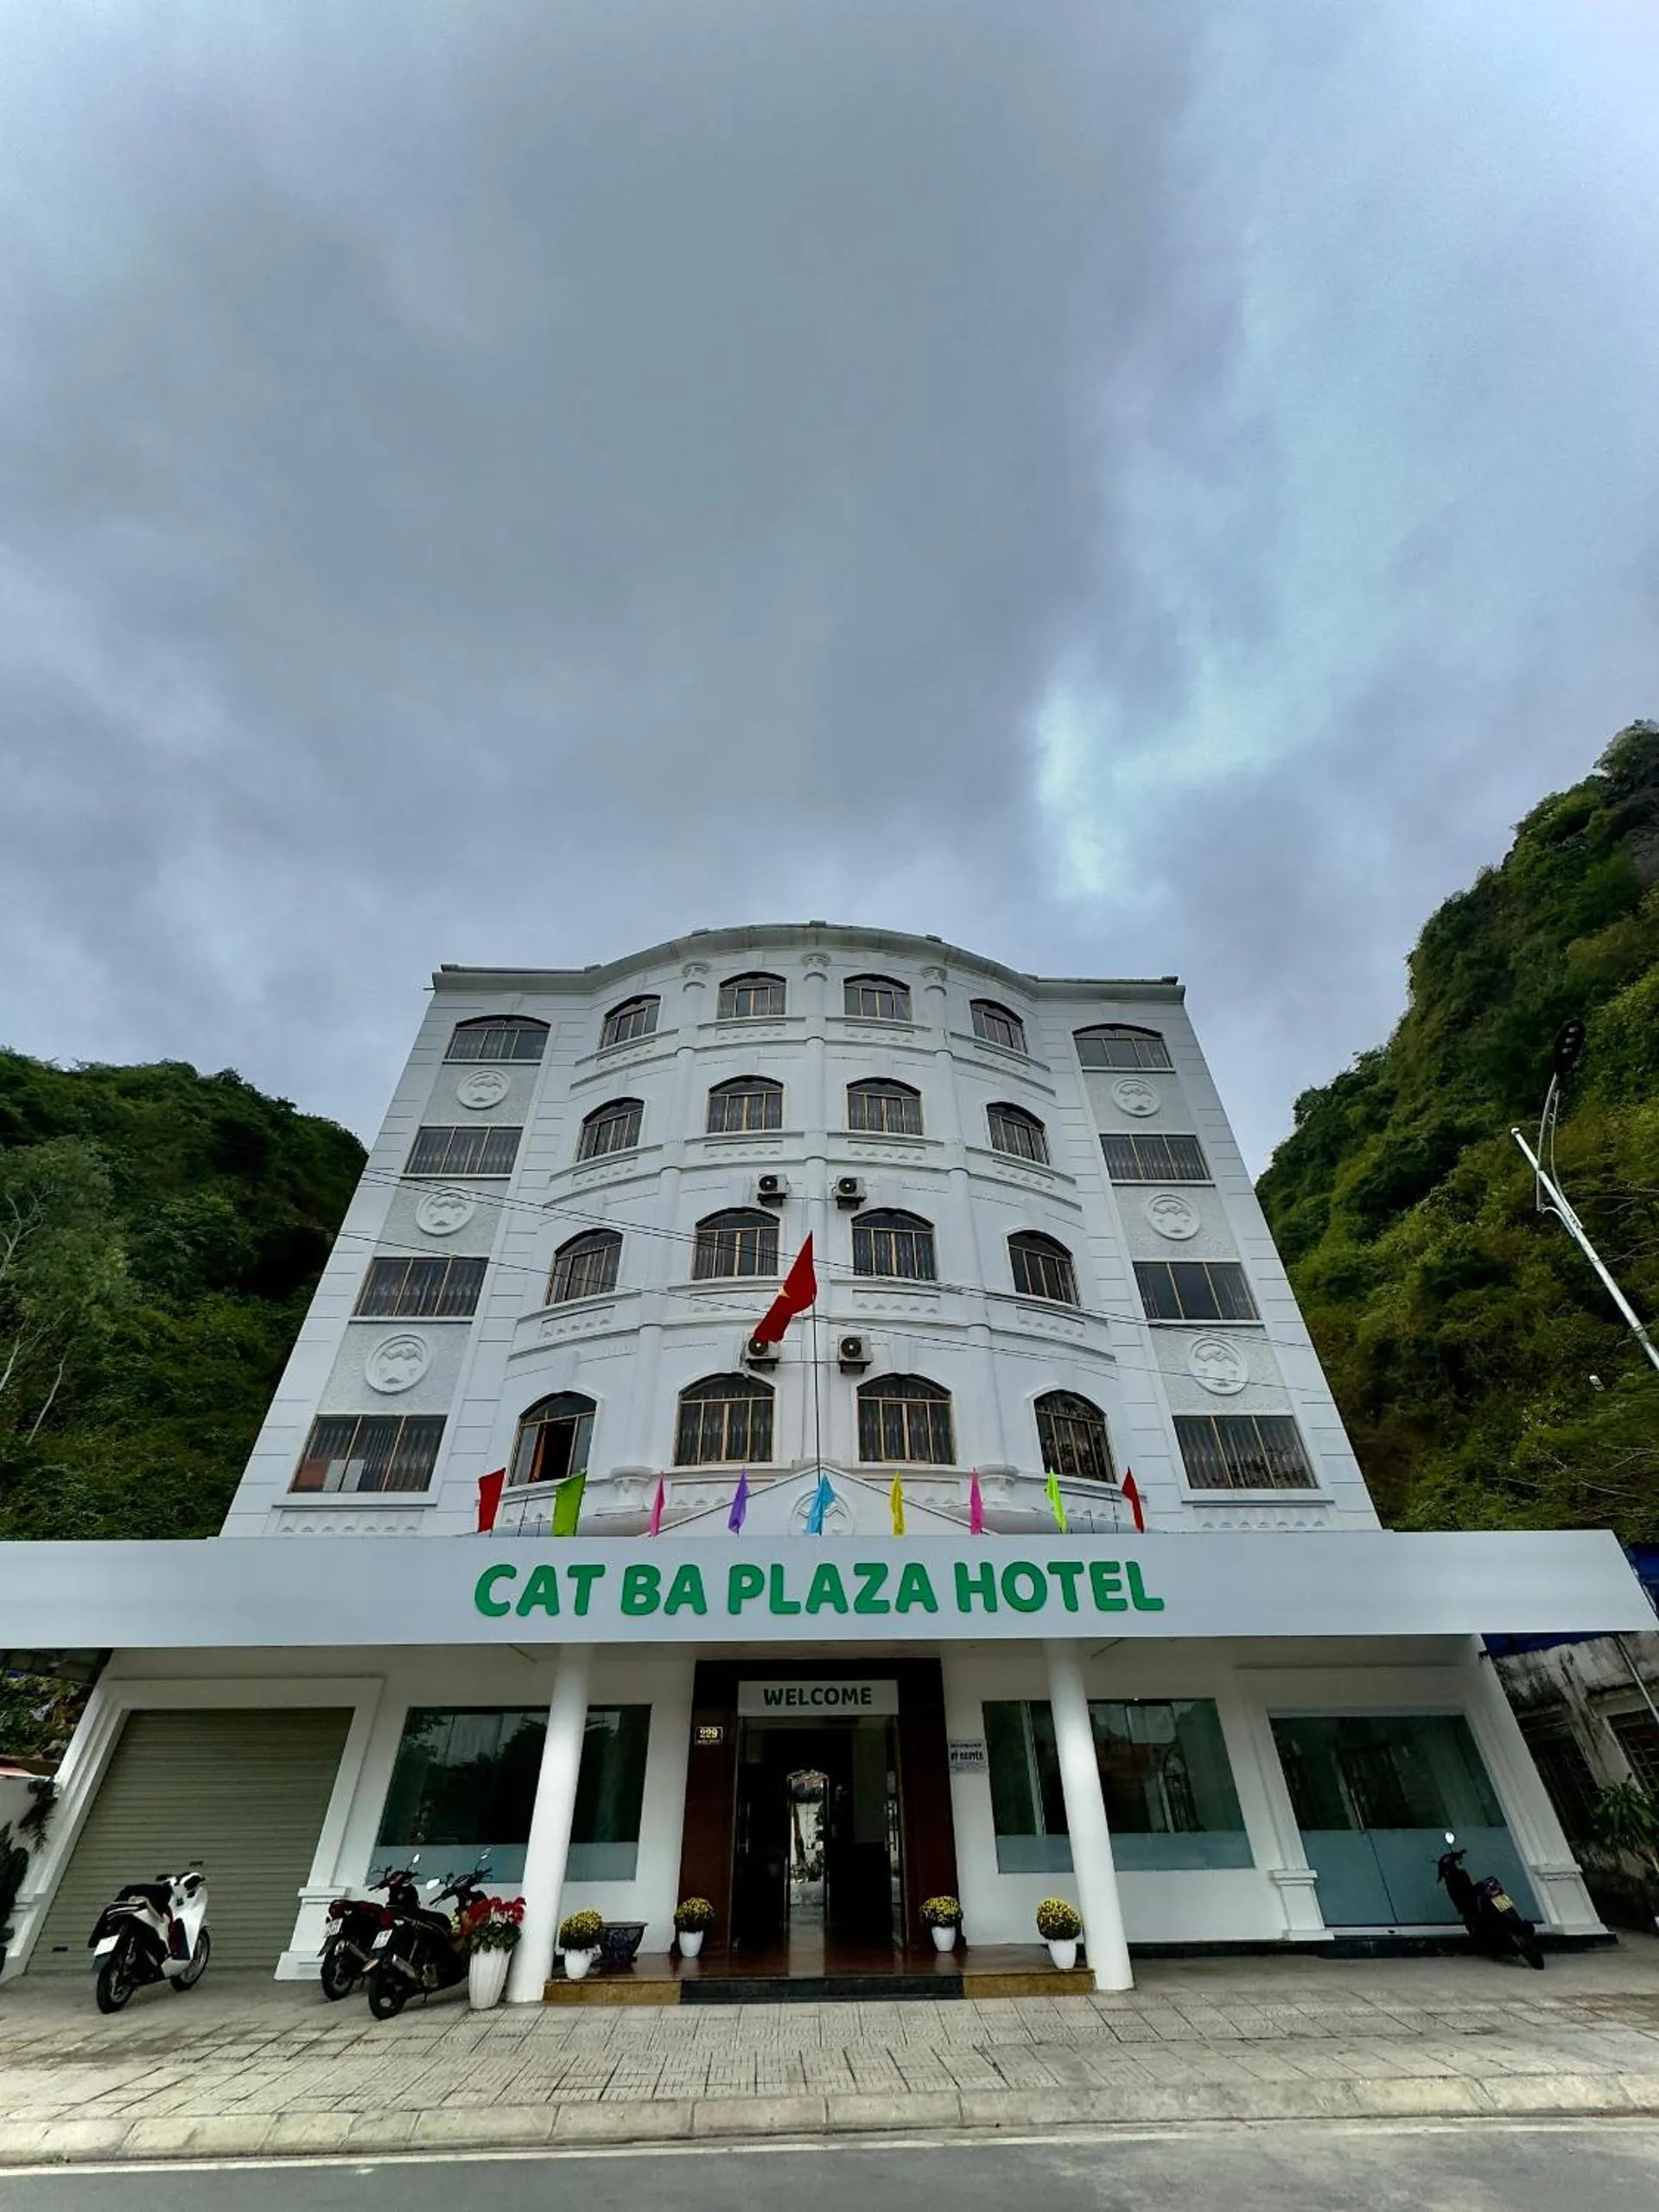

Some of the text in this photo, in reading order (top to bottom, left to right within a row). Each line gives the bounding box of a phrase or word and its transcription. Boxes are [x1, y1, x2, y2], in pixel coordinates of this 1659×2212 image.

[474, 1561, 1163, 1618] CAT BA PLAZA HOTEL
[763, 1687, 872, 1706] WELCOME
[699, 1727, 718, 1738] 229
